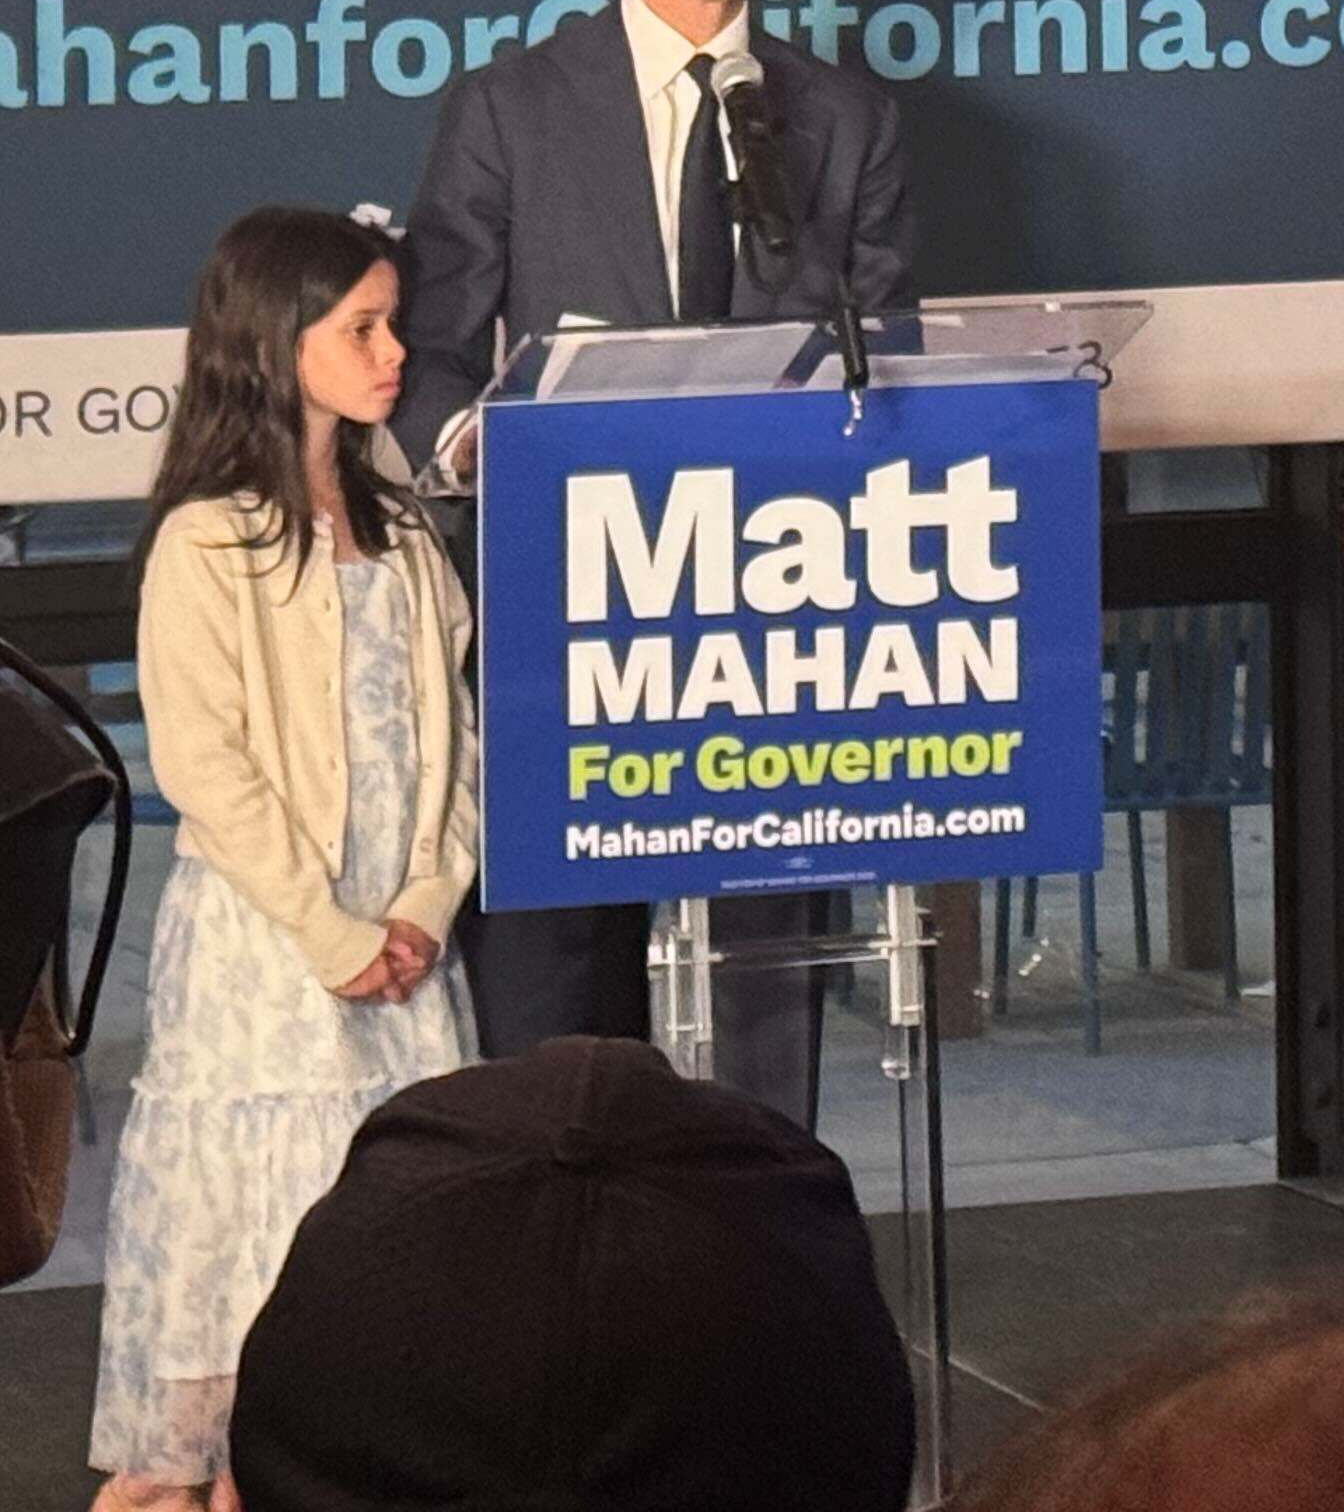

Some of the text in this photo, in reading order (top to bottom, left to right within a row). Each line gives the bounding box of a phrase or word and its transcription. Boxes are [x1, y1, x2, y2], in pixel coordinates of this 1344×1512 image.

[565, 455, 1020, 623] Matt
[566, 617, 1018, 727] MAHAN
[568, 730, 1023, 801] For Governor
[565, 802, 1026, 861] MahanForCalifornia.com
